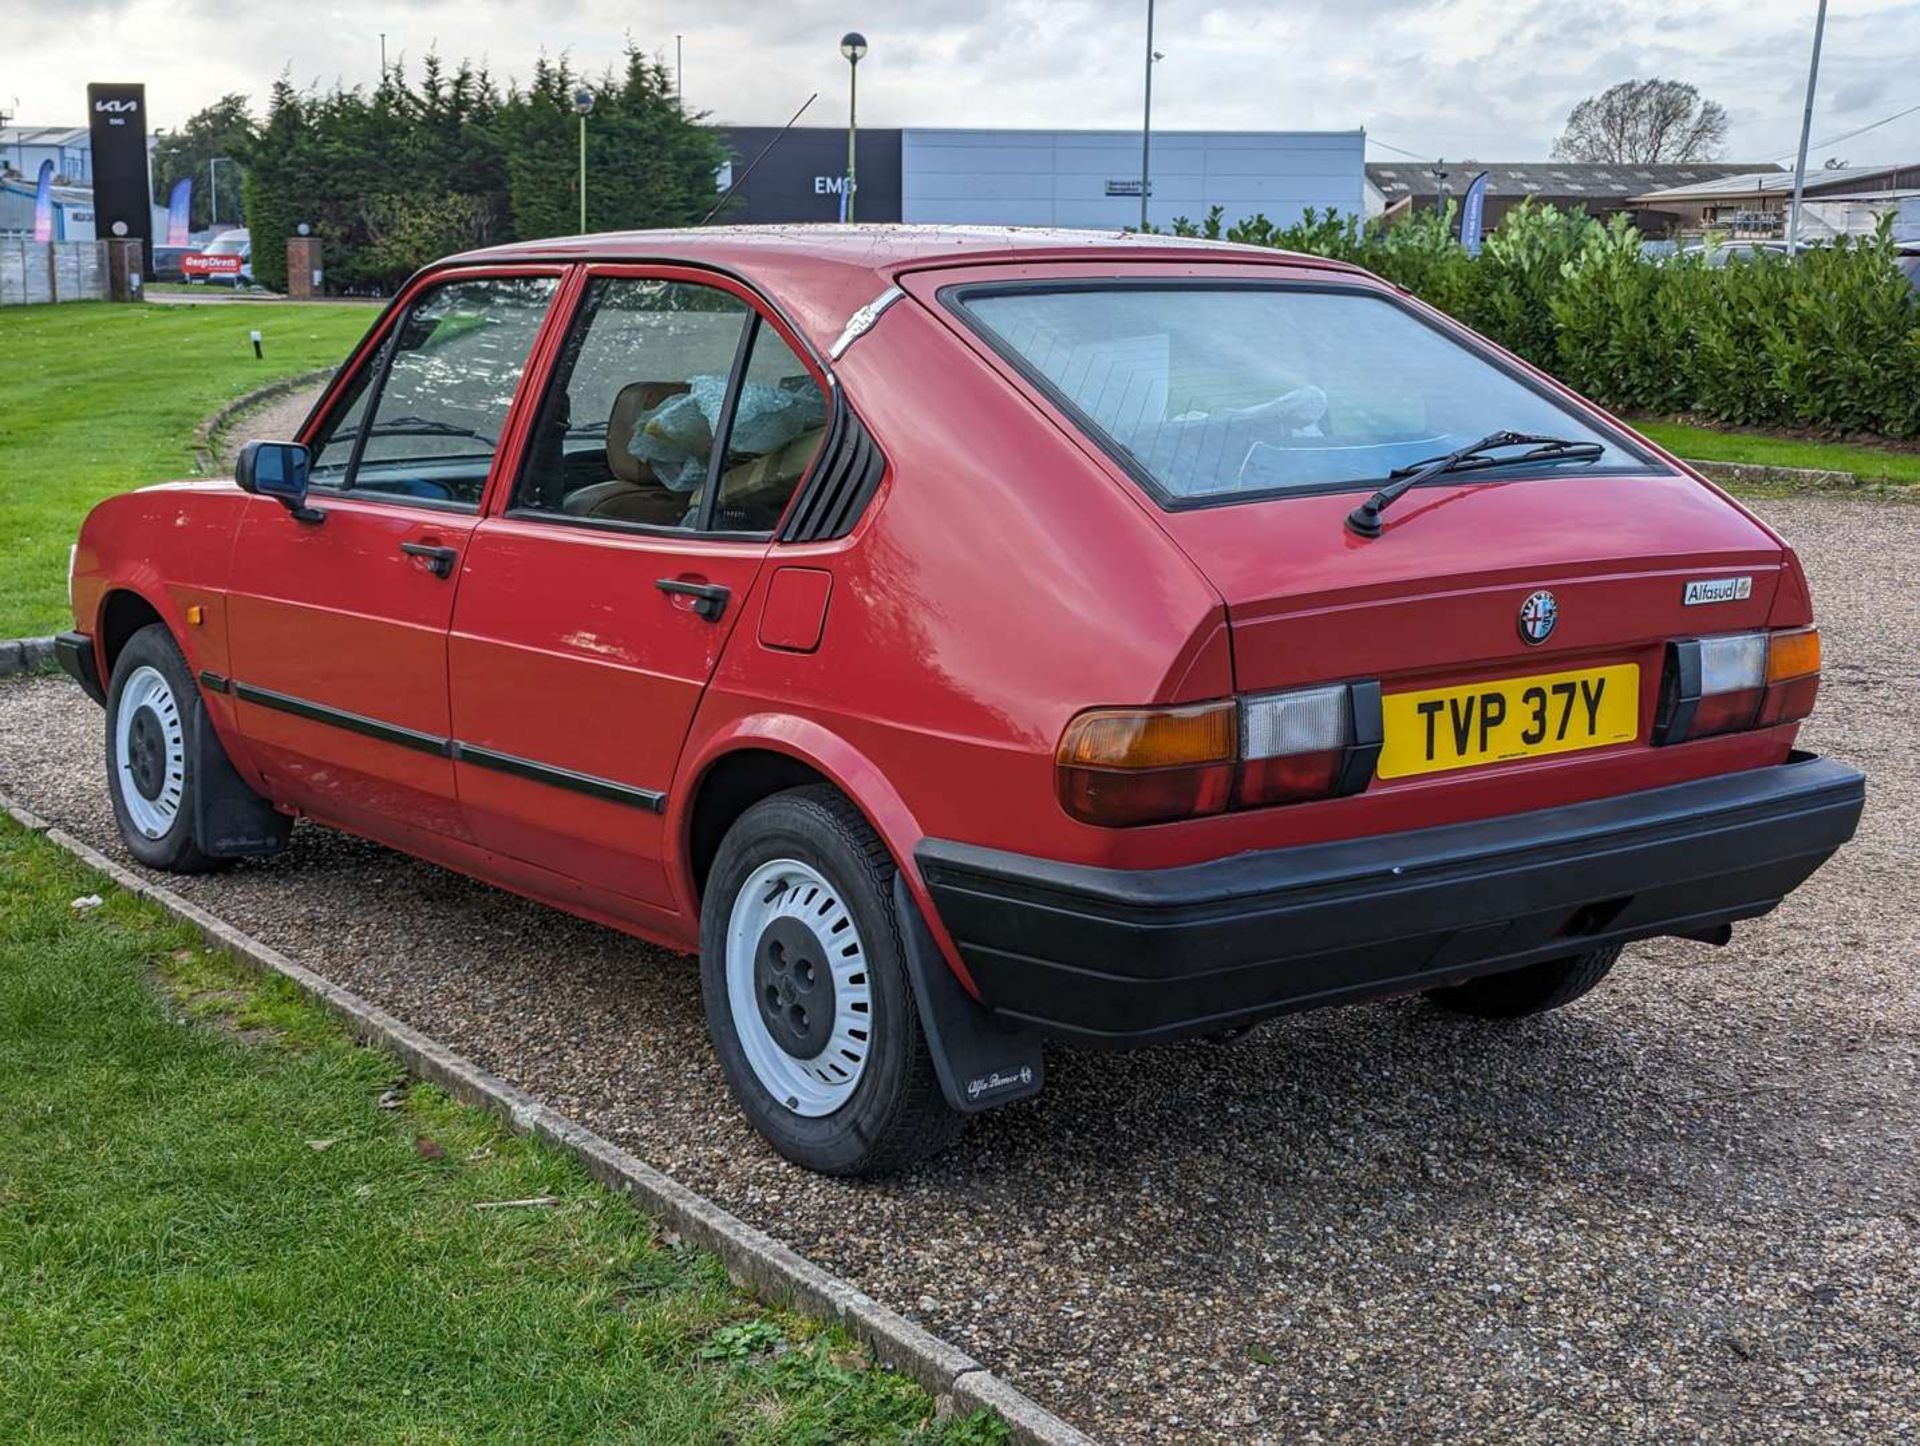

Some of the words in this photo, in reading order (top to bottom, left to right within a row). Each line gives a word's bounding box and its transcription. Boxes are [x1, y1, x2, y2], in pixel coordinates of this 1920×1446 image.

[1687, 580, 1735, 602] Alfasud
[1417, 692, 1507, 761] TVP
[1521, 678, 1606, 745] 37Y
